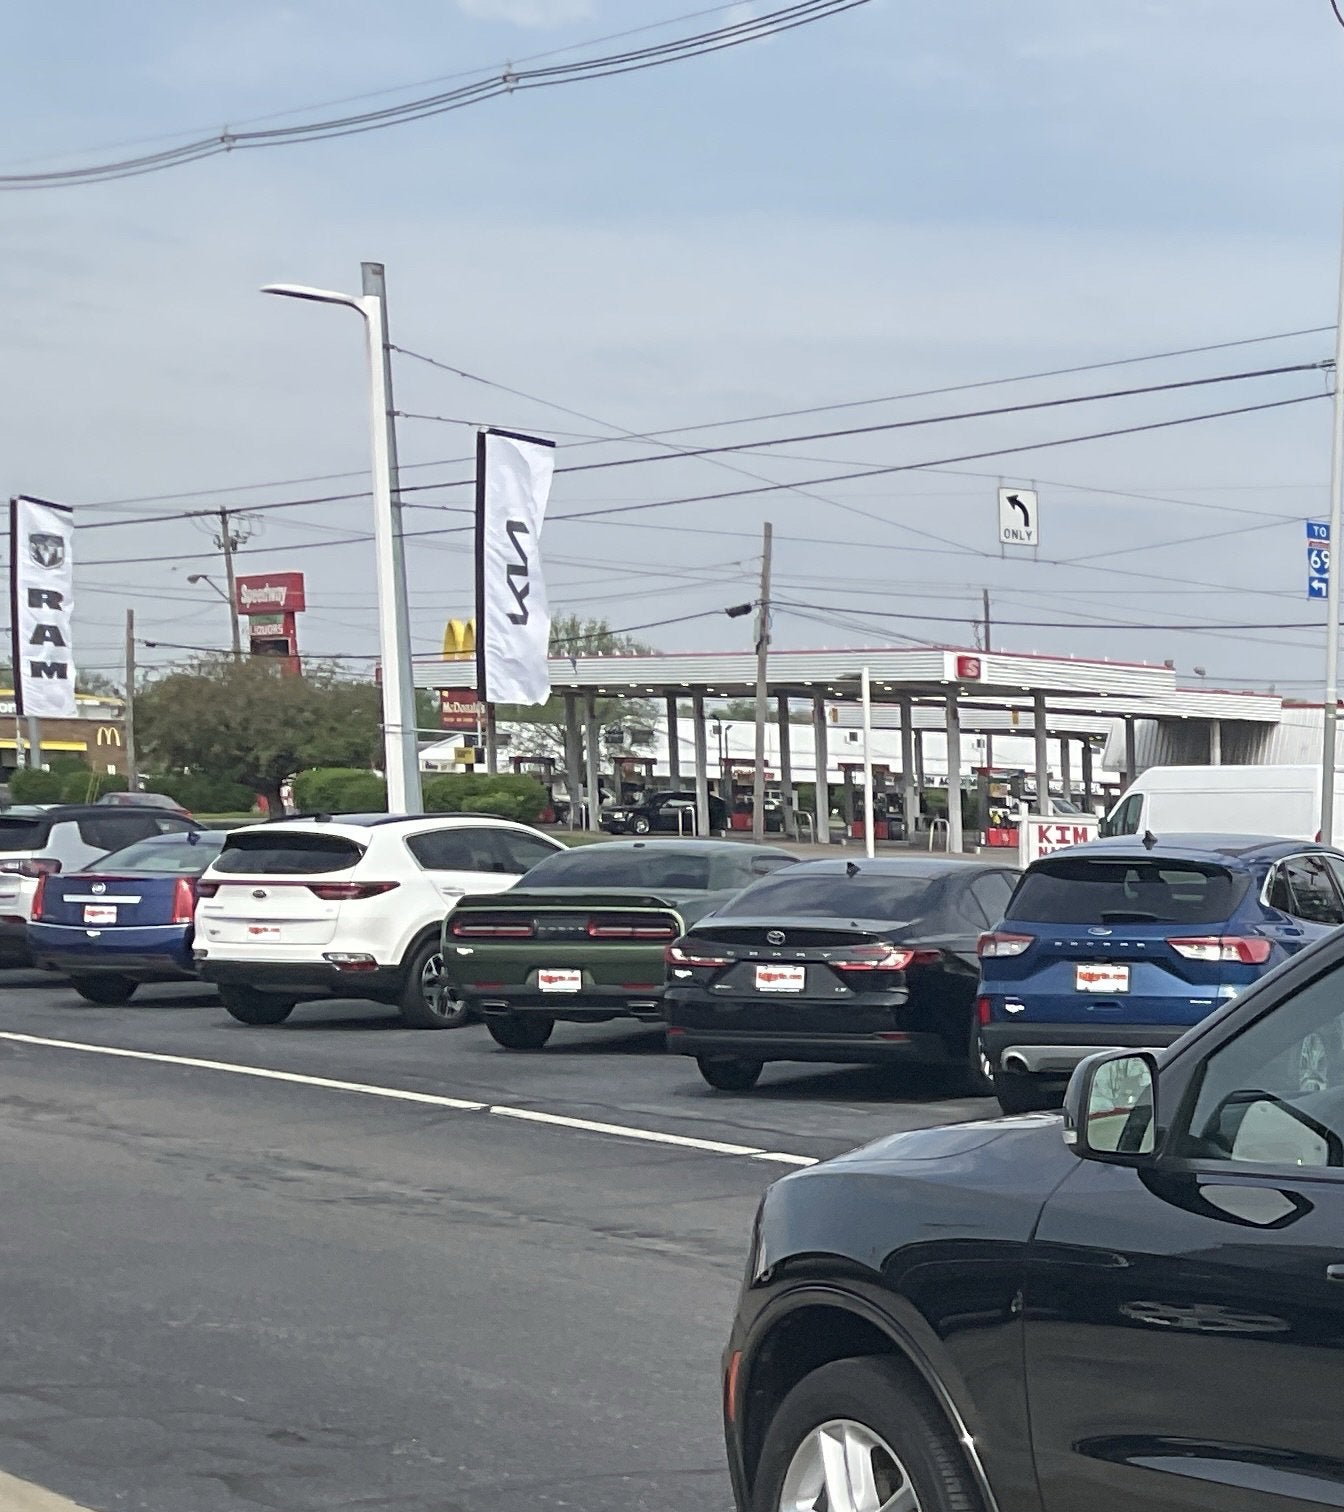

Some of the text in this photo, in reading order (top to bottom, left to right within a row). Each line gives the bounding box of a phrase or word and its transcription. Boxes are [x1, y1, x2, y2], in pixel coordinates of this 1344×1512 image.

[1003, 528, 1032, 541] ONLY
[1313, 525, 1327, 538] TO
[1310, 550, 1330, 569] 69
[27, 587, 69, 680] RAM
[1038, 824, 1088, 845] KIM
